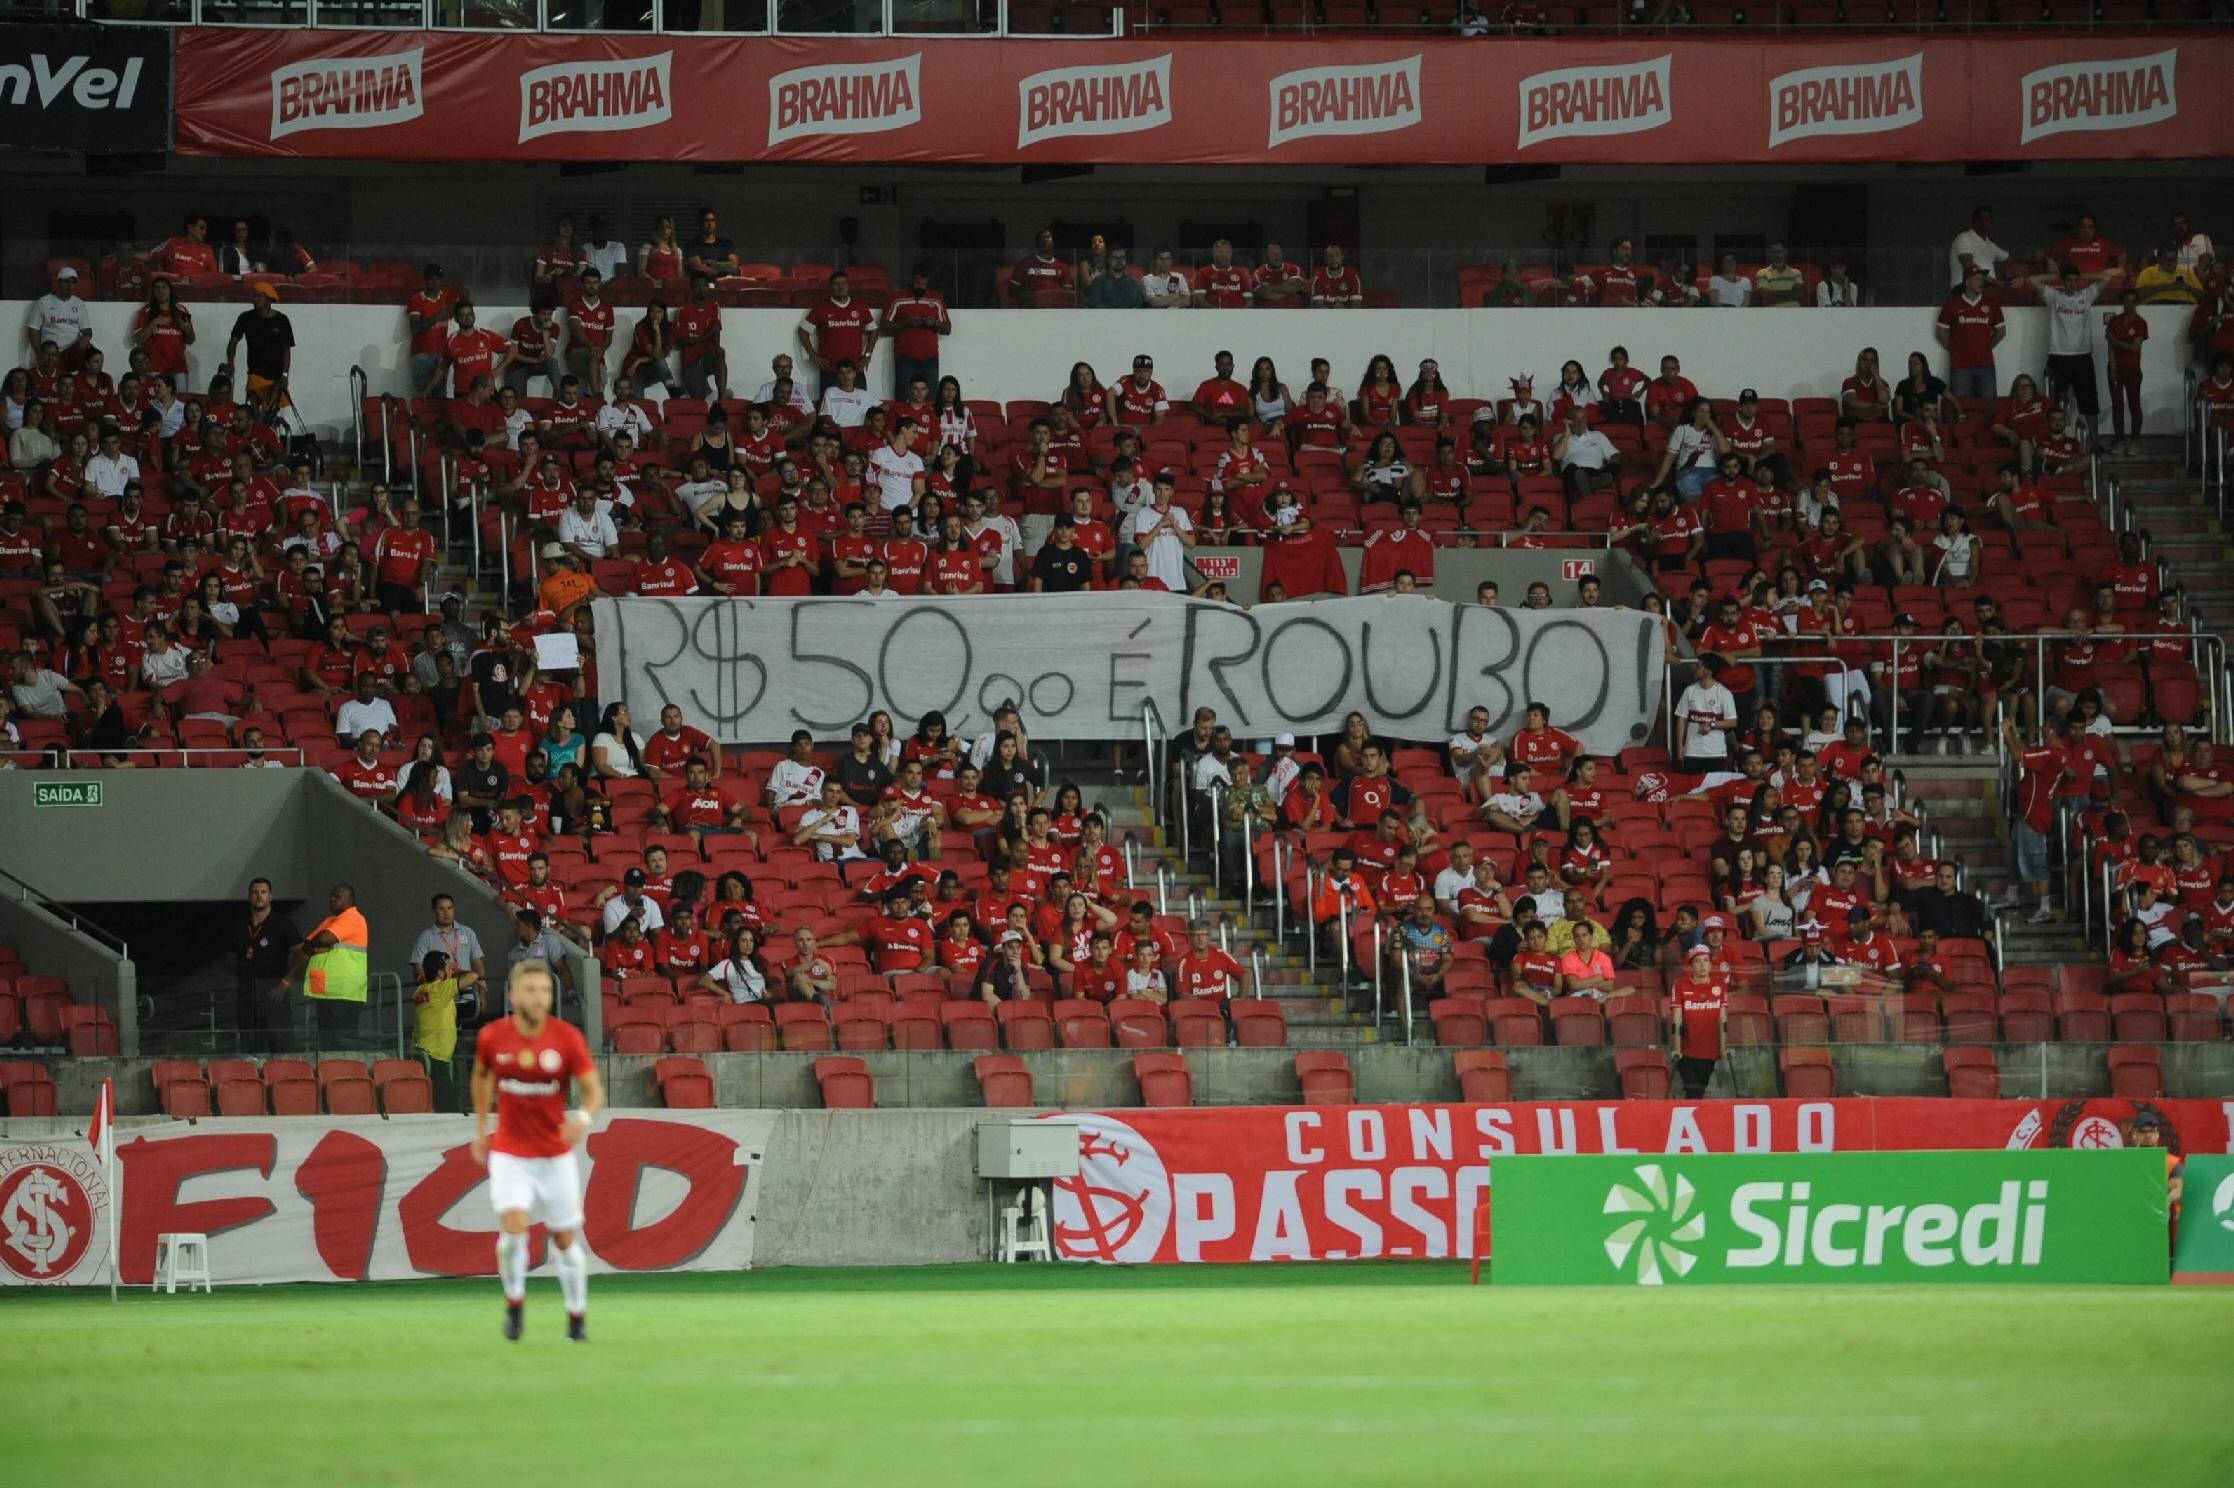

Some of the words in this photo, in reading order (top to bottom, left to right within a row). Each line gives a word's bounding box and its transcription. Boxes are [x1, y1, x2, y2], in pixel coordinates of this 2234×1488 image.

[0, 53, 144, 110] nVel
[280, 63, 416, 124] BRAHMA
[530, 66, 663, 125] BRAHMA
[780, 70, 914, 129] BRAHMA
[1029, 71, 1163, 130] BRAHMA
[1279, 71, 1414, 130] BRAHMA
[1528, 70, 1664, 130] BRAHMA
[1778, 70, 1914, 130] BRAHMA
[2030, 65, 2168, 127] BRAHMA
[828, 319, 860, 328] Banrisul
[1958, 315, 1990, 325] Banrisul
[641, 580, 675, 591] Banrisul
[723, 562, 753, 571] Banrisul
[891, 567, 921, 576] Banrisul
[1565, 563, 1592, 578] 14
[2115, 583, 2147, 593] Banrisul
[1110, 617, 1152, 721] É
[1180, 601, 1654, 740] ROUBO!
[39, 786, 83, 802] SAÍDA
[1684, 999, 1721, 1010] Banrisul
[1285, 1103, 1834, 1164] CONSULADO
[1726, 1180, 2048, 1269] Sicredi
